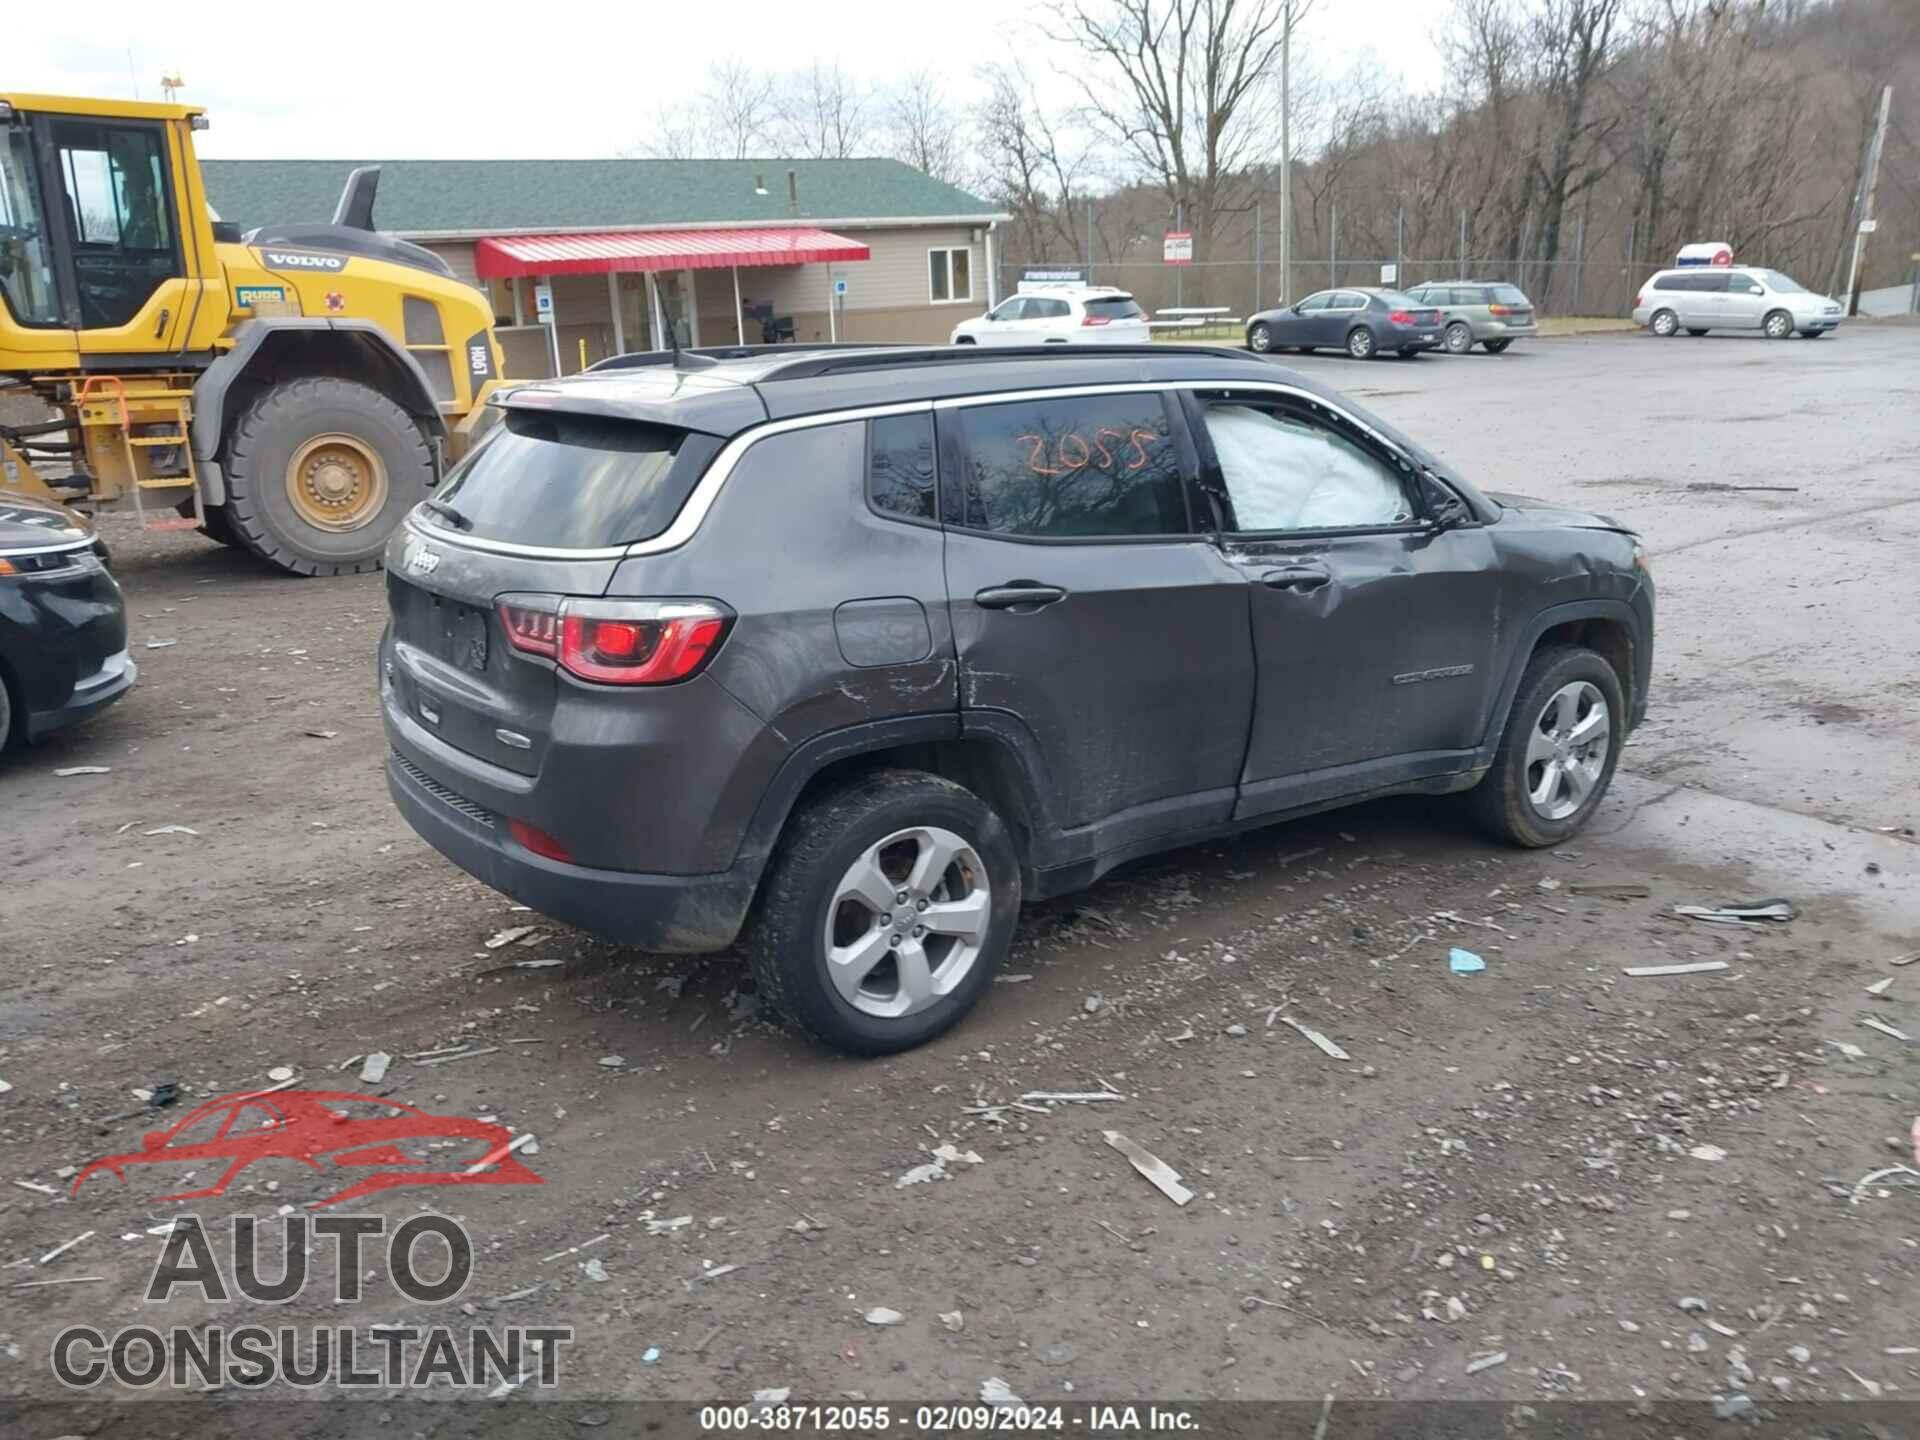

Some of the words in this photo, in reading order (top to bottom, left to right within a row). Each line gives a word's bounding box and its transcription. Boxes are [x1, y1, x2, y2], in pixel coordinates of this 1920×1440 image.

[267, 254, 341, 268] VOLVO
[470, 346, 488, 375] L90H
[1015, 428, 1159, 474] 2055
